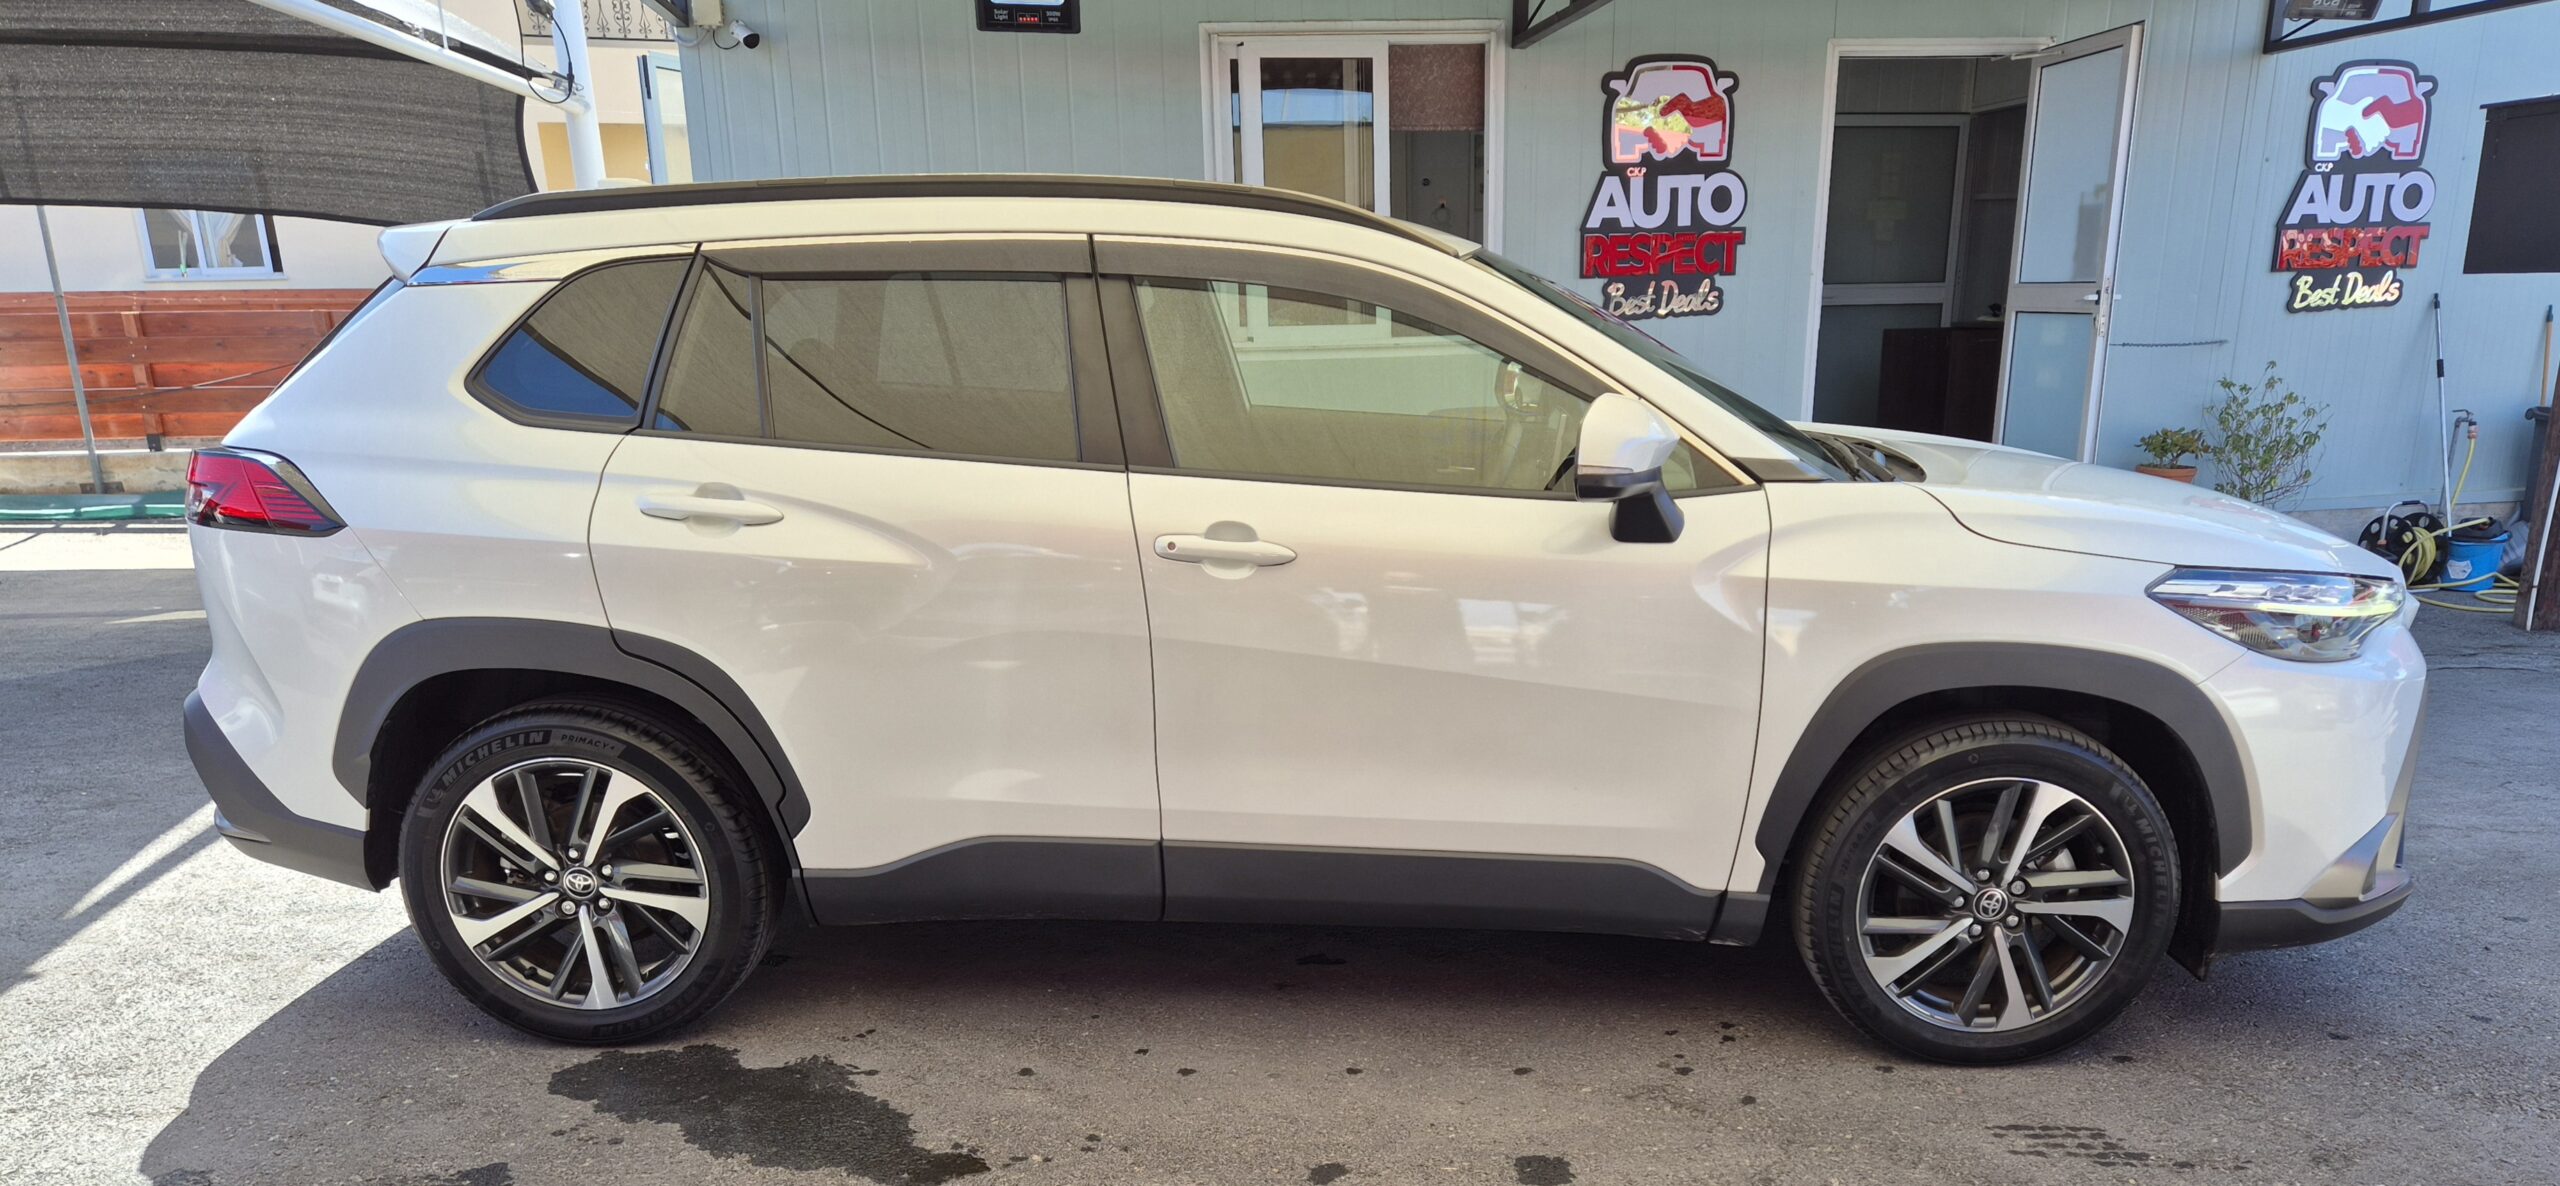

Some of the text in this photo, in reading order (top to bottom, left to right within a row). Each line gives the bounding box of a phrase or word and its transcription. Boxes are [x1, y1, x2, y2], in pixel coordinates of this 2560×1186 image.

[1585, 171, 1748, 229] AUTO
[2284, 170, 2436, 225] AUTO
[1583, 230, 1745, 277] RESPECT
[2279, 224, 2430, 270] RESPECT
[1606, 278, 1720, 316] Best Deals
[2292, 270, 2401, 312] Best Deals
[442, 731, 544, 787] MICHELIN
